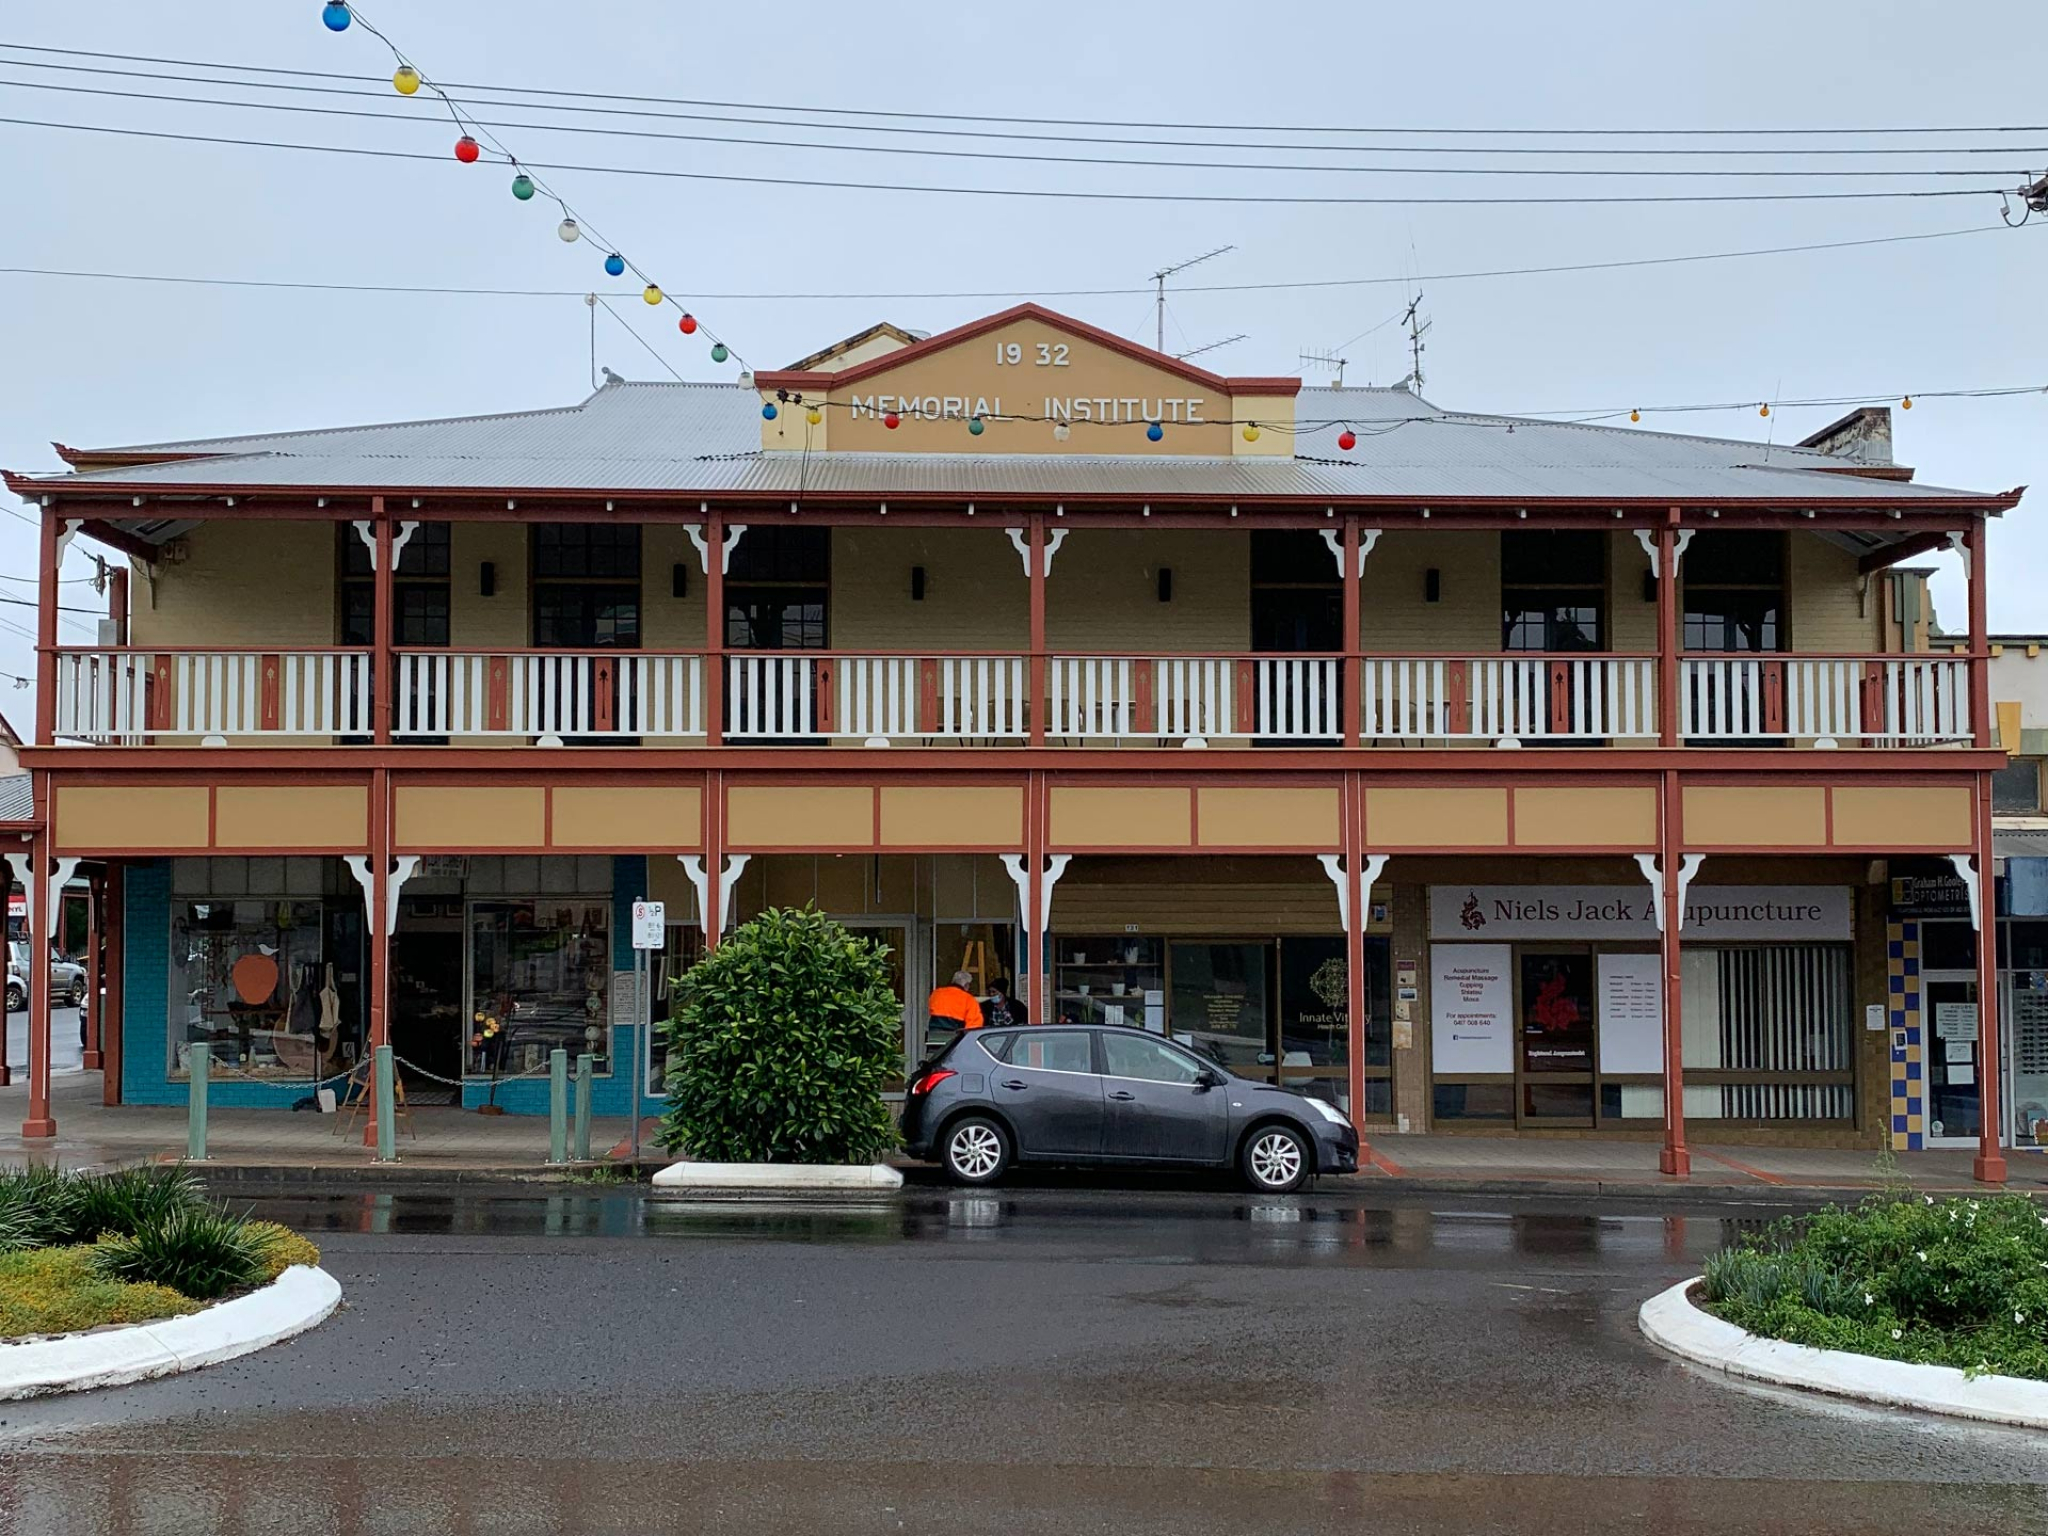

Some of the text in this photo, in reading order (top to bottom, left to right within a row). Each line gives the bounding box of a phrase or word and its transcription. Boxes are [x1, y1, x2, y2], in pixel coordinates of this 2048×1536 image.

[997, 342, 1070, 366] 19 32
[851, 395, 1204, 422] MEMORIAL INSTITUTE
[1914, 888, 1968, 902] OPTOMETRIS
[1494, 899, 1822, 926] Niels Jack Aupuncture
[1299, 1011, 1332, 1023] Innate
